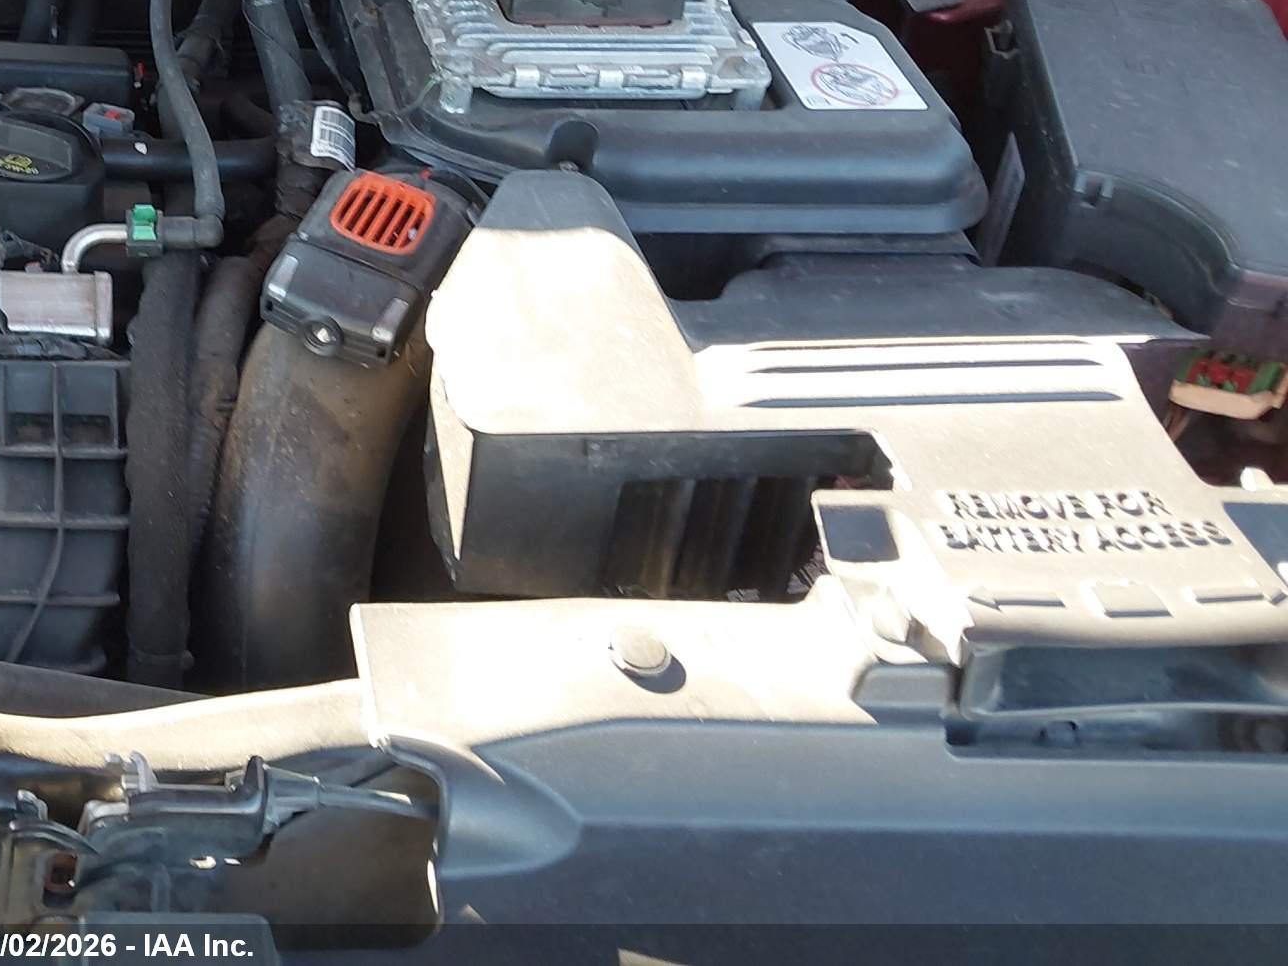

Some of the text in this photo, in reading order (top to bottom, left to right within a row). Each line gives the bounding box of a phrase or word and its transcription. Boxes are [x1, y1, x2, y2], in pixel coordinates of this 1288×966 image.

[945, 489, 1172, 521] REMOVE FOR
[938, 519, 1233, 553] BATTERY ACCESS
